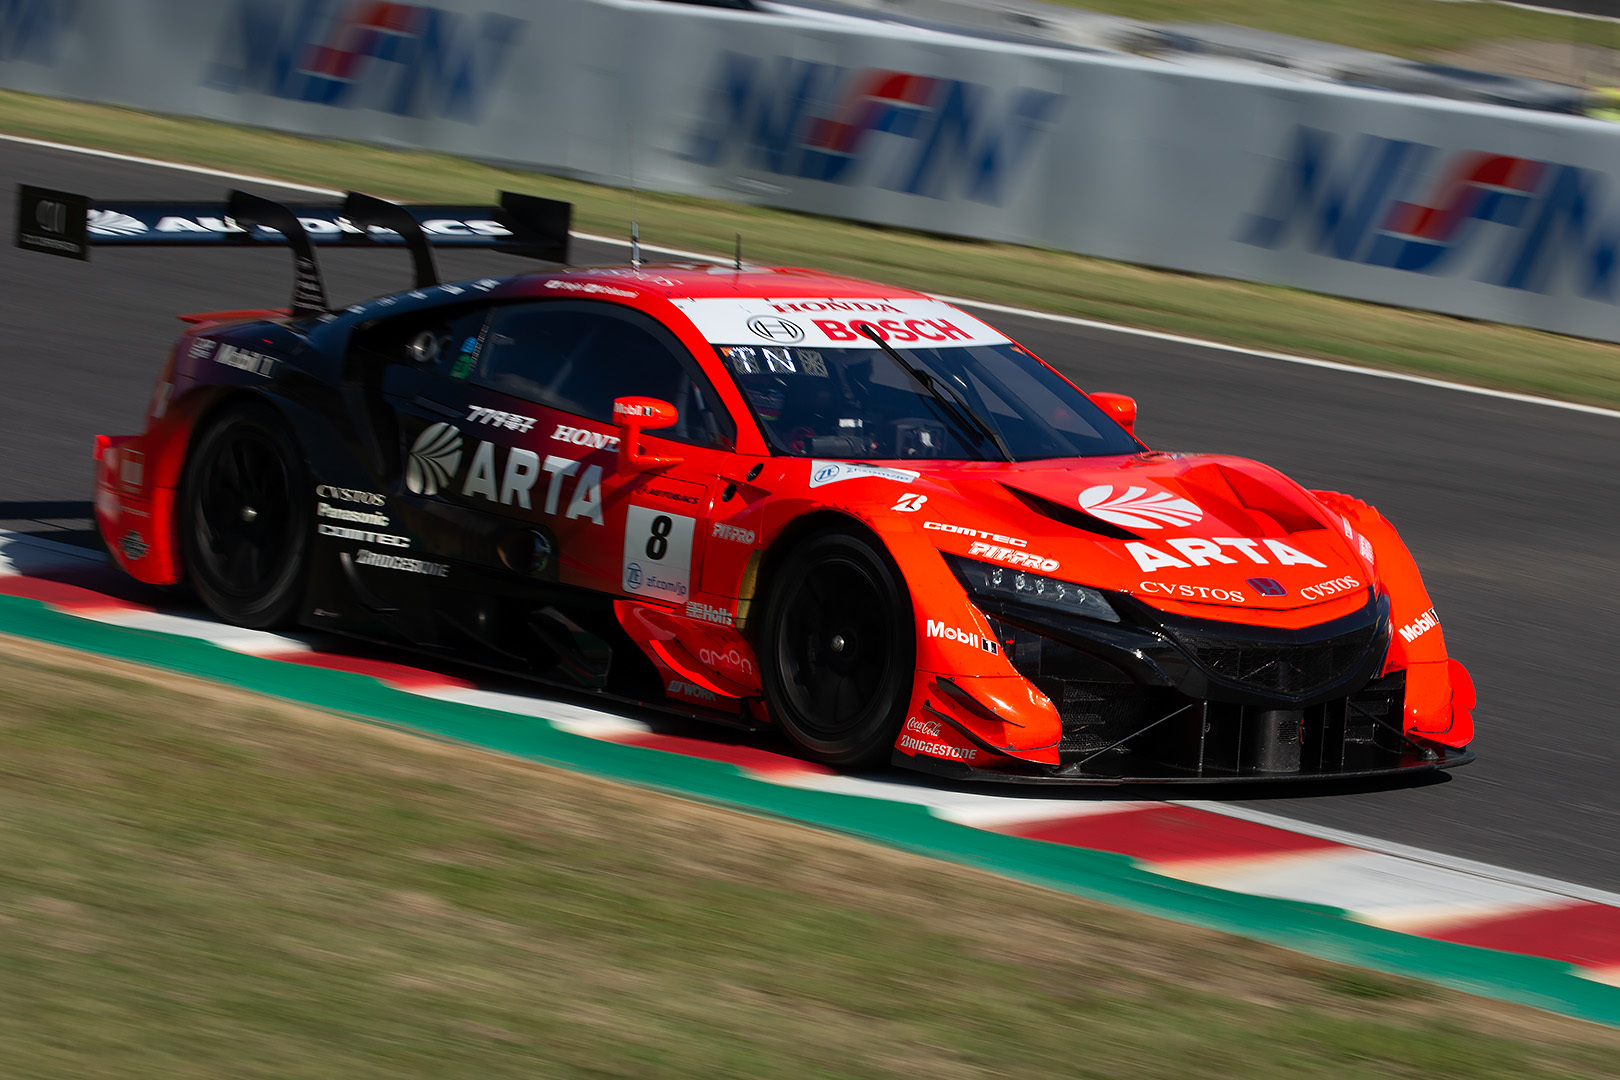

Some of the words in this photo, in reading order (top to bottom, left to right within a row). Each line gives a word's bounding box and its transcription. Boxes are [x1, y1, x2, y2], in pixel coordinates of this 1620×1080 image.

[154, 215, 513, 236] AUOCS
[770, 302, 907, 314] HONDA
[812, 319, 975, 342] BOSCH
[614, 402, 642, 416] Mobil
[549, 424, 621, 453] HOND
[461, 440, 605, 526] ARTA
[317, 502, 390, 527] Panasonic
[317, 524, 411, 549] COMTEC
[646, 515, 672, 560] 8
[923, 521, 1028, 548] COMTEC
[355, 549, 451, 578] BRIDGESTONE
[1124, 537, 1328, 572] ARTA
[1140, 581, 1246, 603] CVSTOS
[1300, 575, 1360, 601] CVSTOS
[703, 604, 733, 625] Holts
[926, 619, 979, 648] Mobil
[1399, 612, 1436, 643] Mobil
[901, 735, 977, 760] BRIDGESTONE
